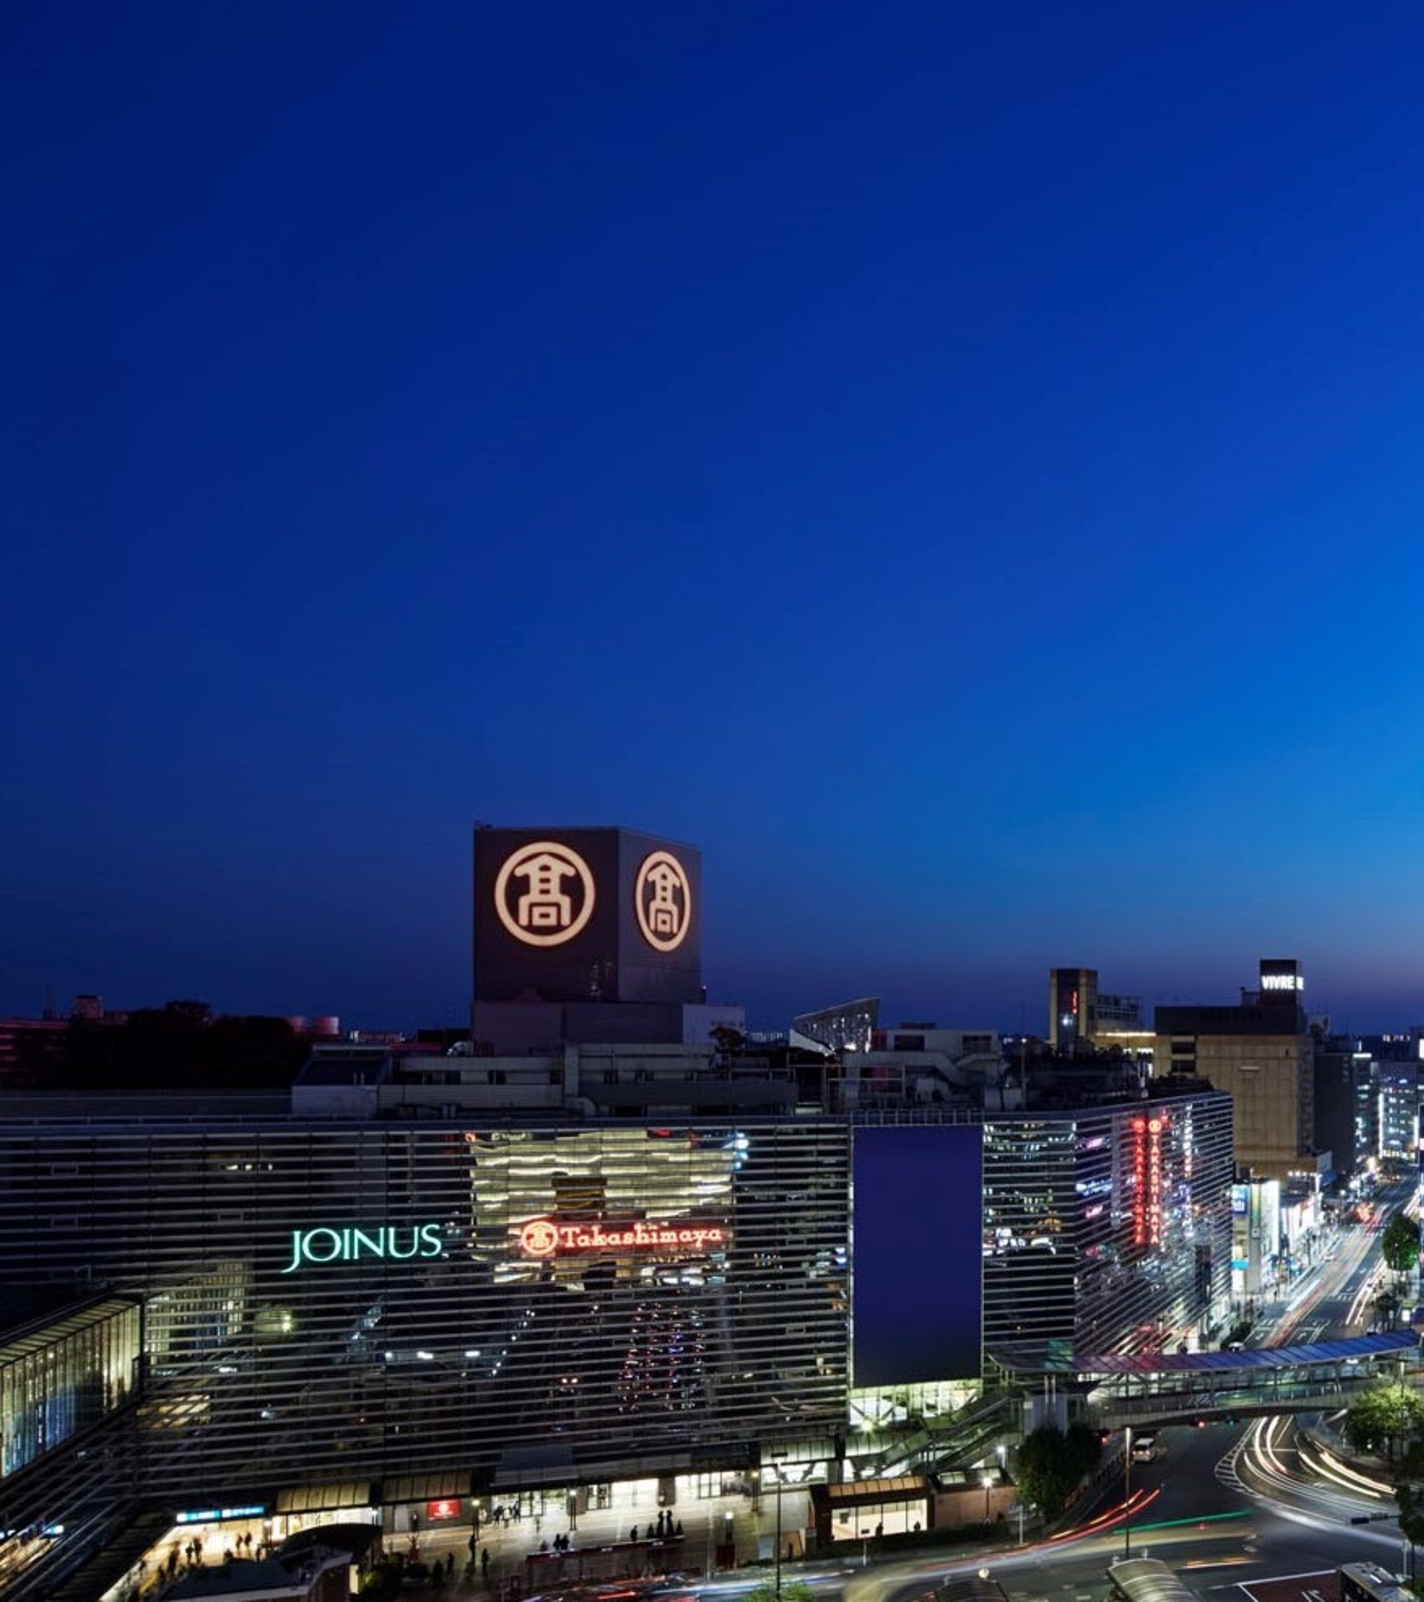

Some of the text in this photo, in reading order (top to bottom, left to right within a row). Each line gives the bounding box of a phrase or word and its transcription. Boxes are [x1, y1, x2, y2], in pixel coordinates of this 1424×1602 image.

[1261, 975, 1295, 990] VIVRE
[1150, 1134, 1160, 1244] TAKASHIMAYA
[280, 1223, 443, 1274] JOINUS
[559, 1223, 723, 1249] Takashimaya
